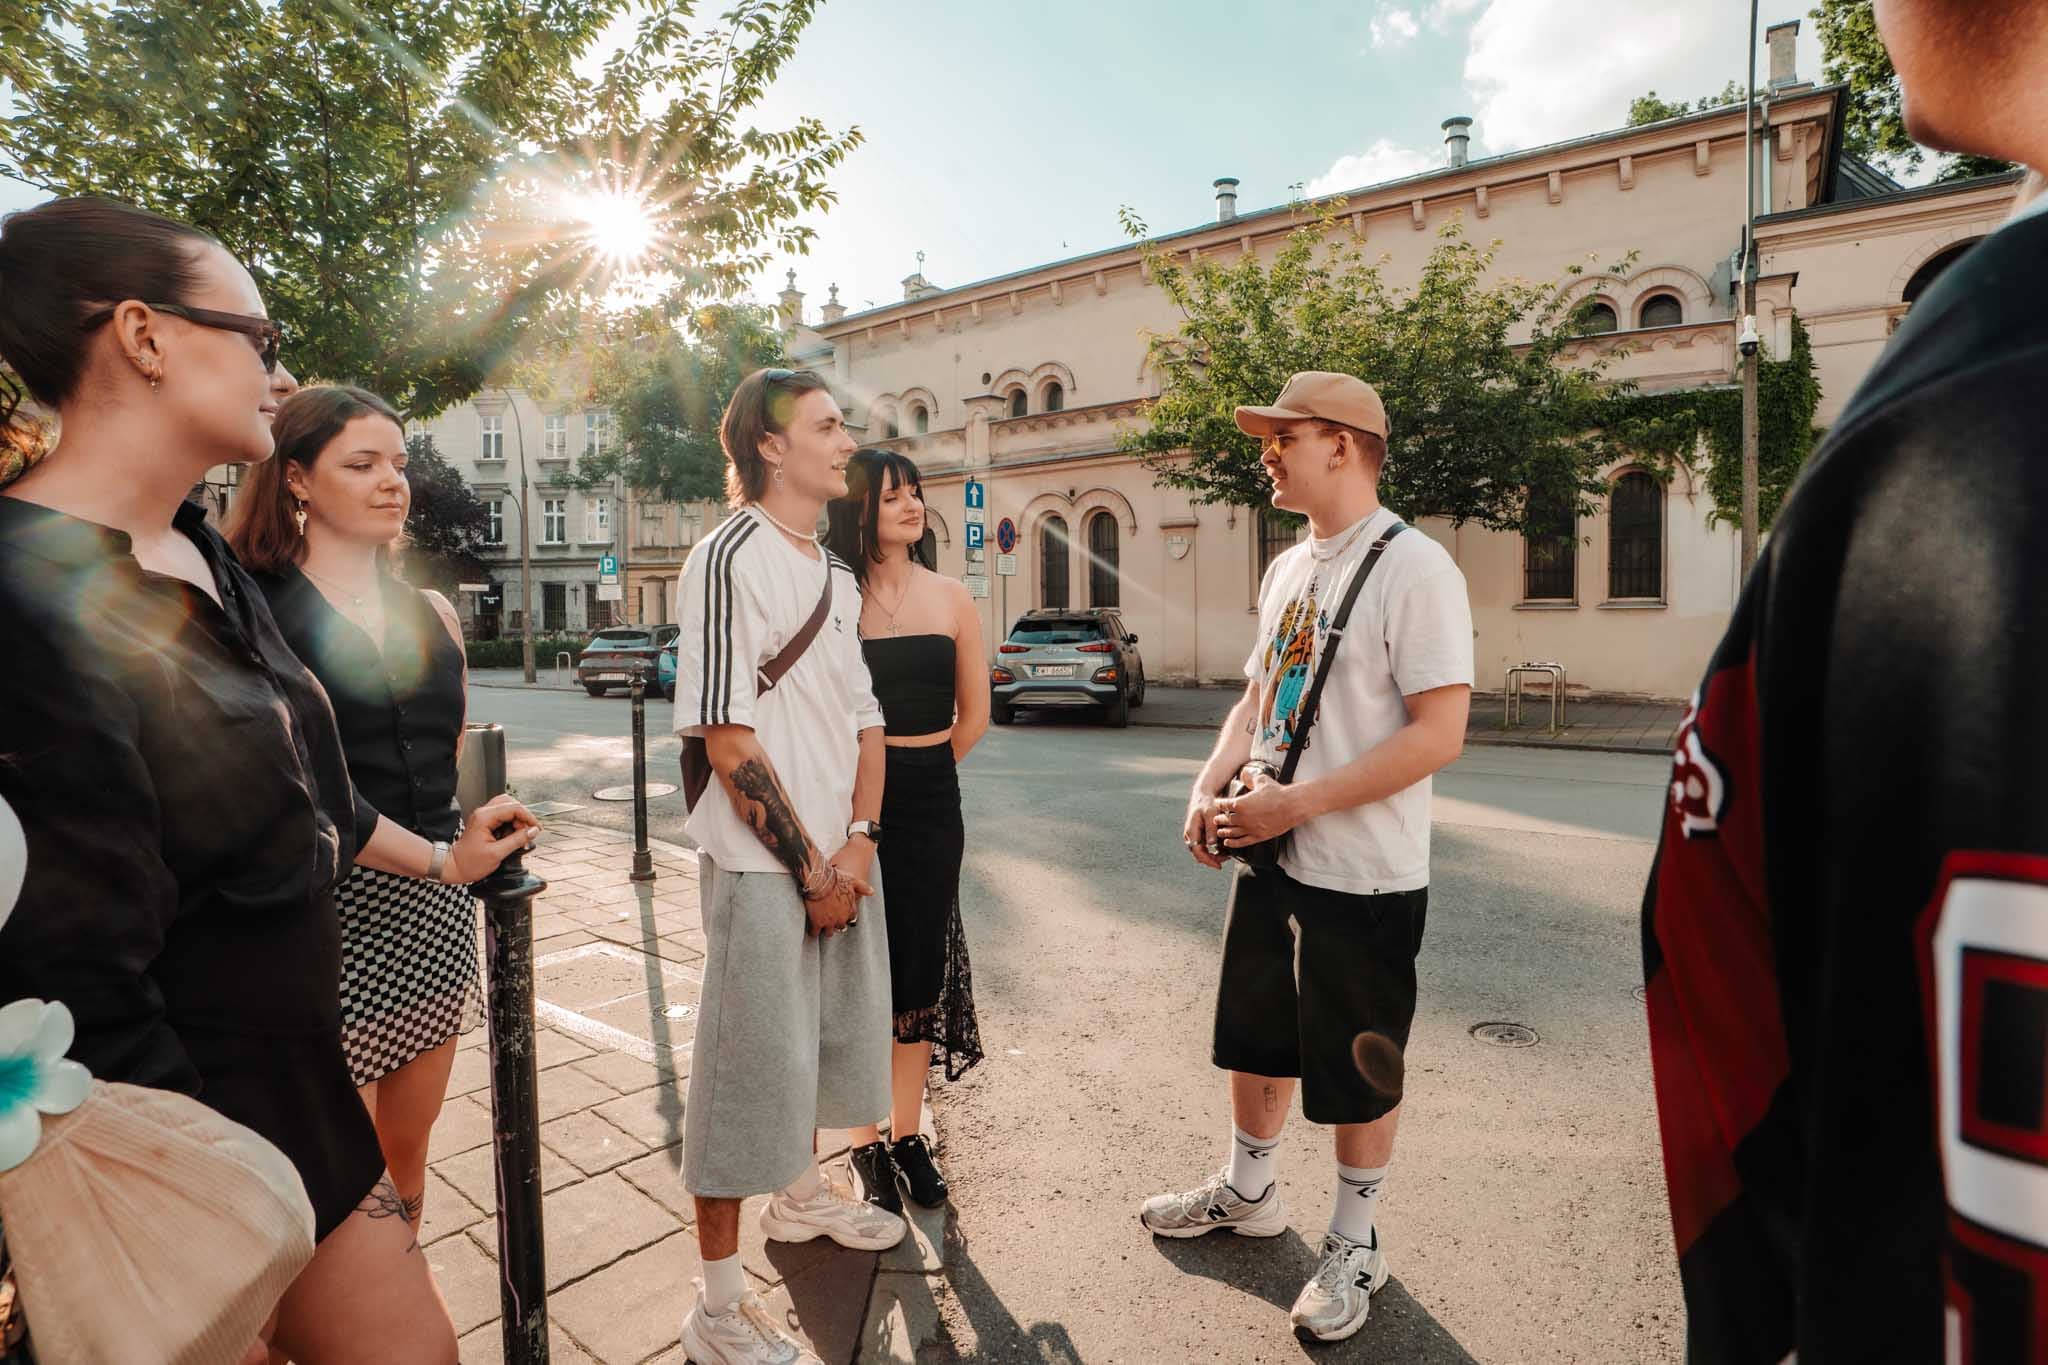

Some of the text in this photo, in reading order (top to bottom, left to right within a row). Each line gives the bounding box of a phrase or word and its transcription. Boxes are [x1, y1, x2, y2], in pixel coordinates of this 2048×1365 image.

[970, 526, 981, 546] P
[603, 558, 614, 572] P
[1202, 1203, 1230, 1222] N
[1353, 1270, 1373, 1291] N
